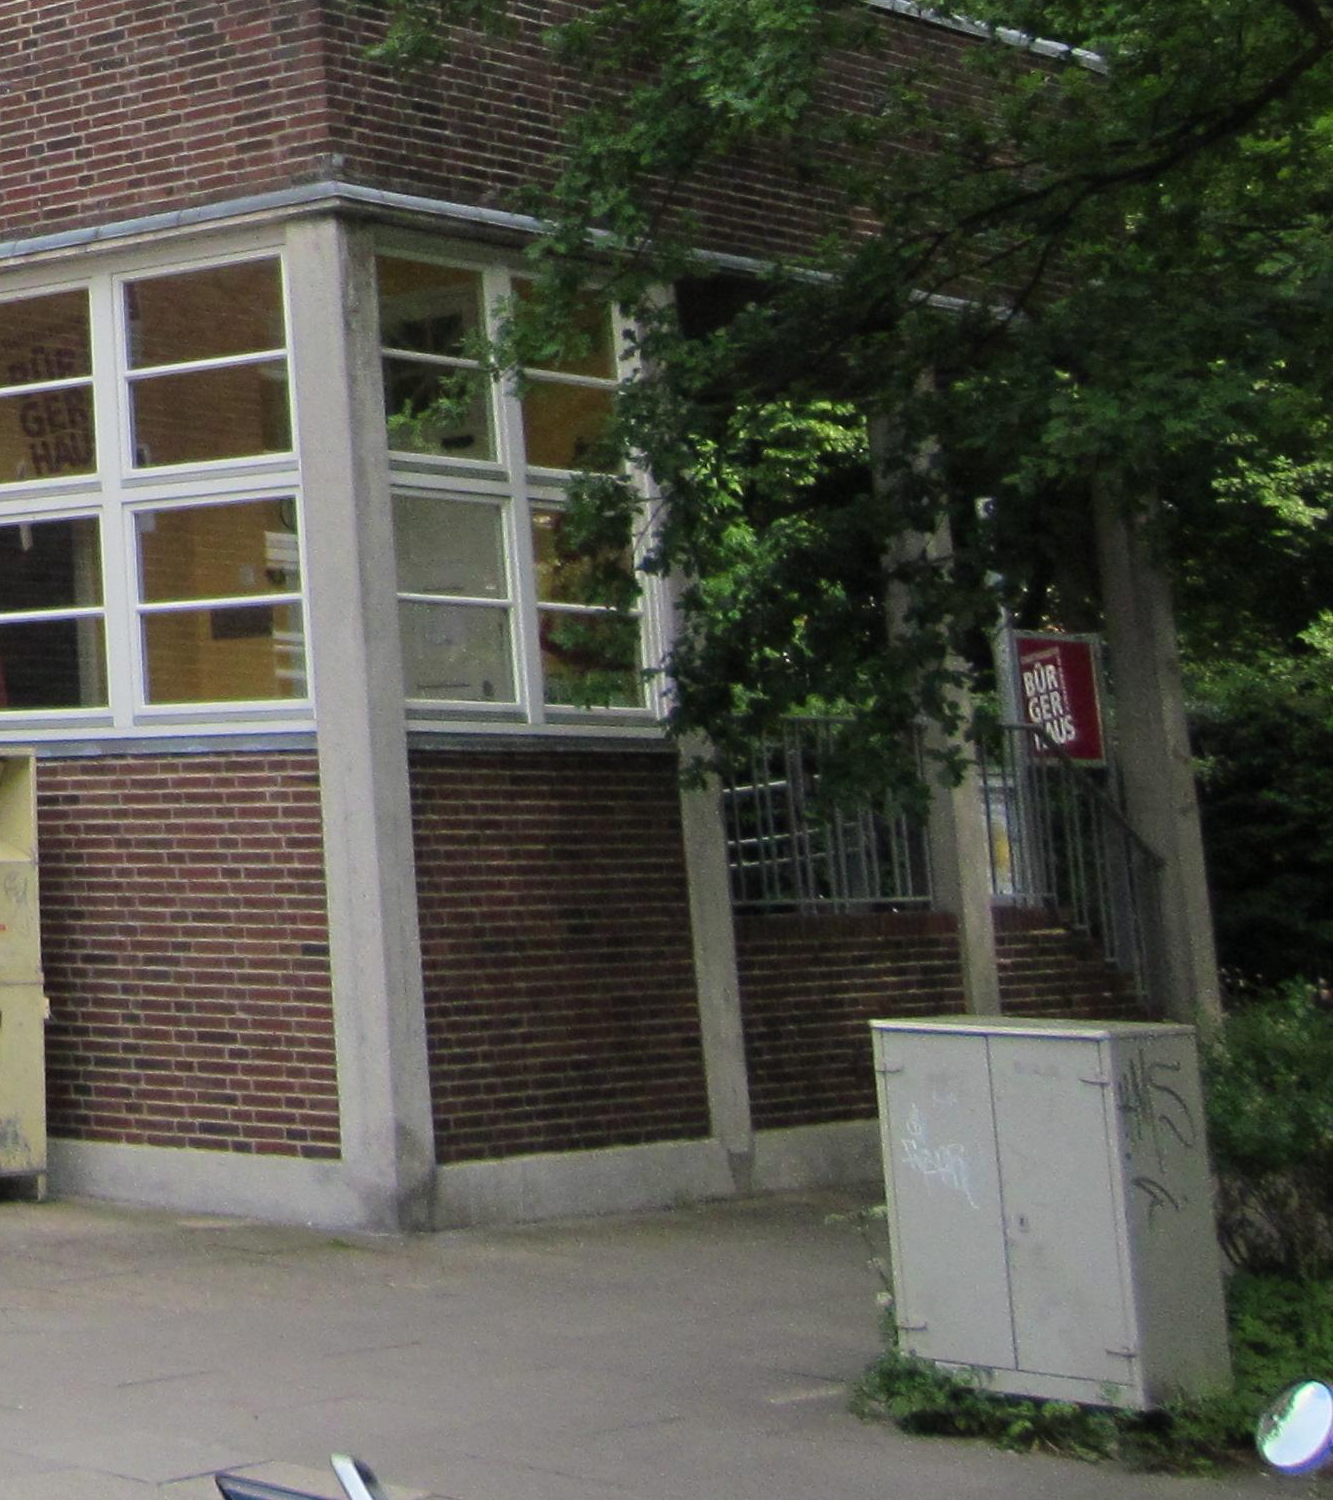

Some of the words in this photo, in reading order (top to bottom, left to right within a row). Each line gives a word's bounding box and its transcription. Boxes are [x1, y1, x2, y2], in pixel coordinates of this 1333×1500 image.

[19, 393, 90, 438] GER
[30, 430, 94, 477] HAU
[1023, 661, 1059, 698] BÜR
[1028, 690, 1064, 724] GER
